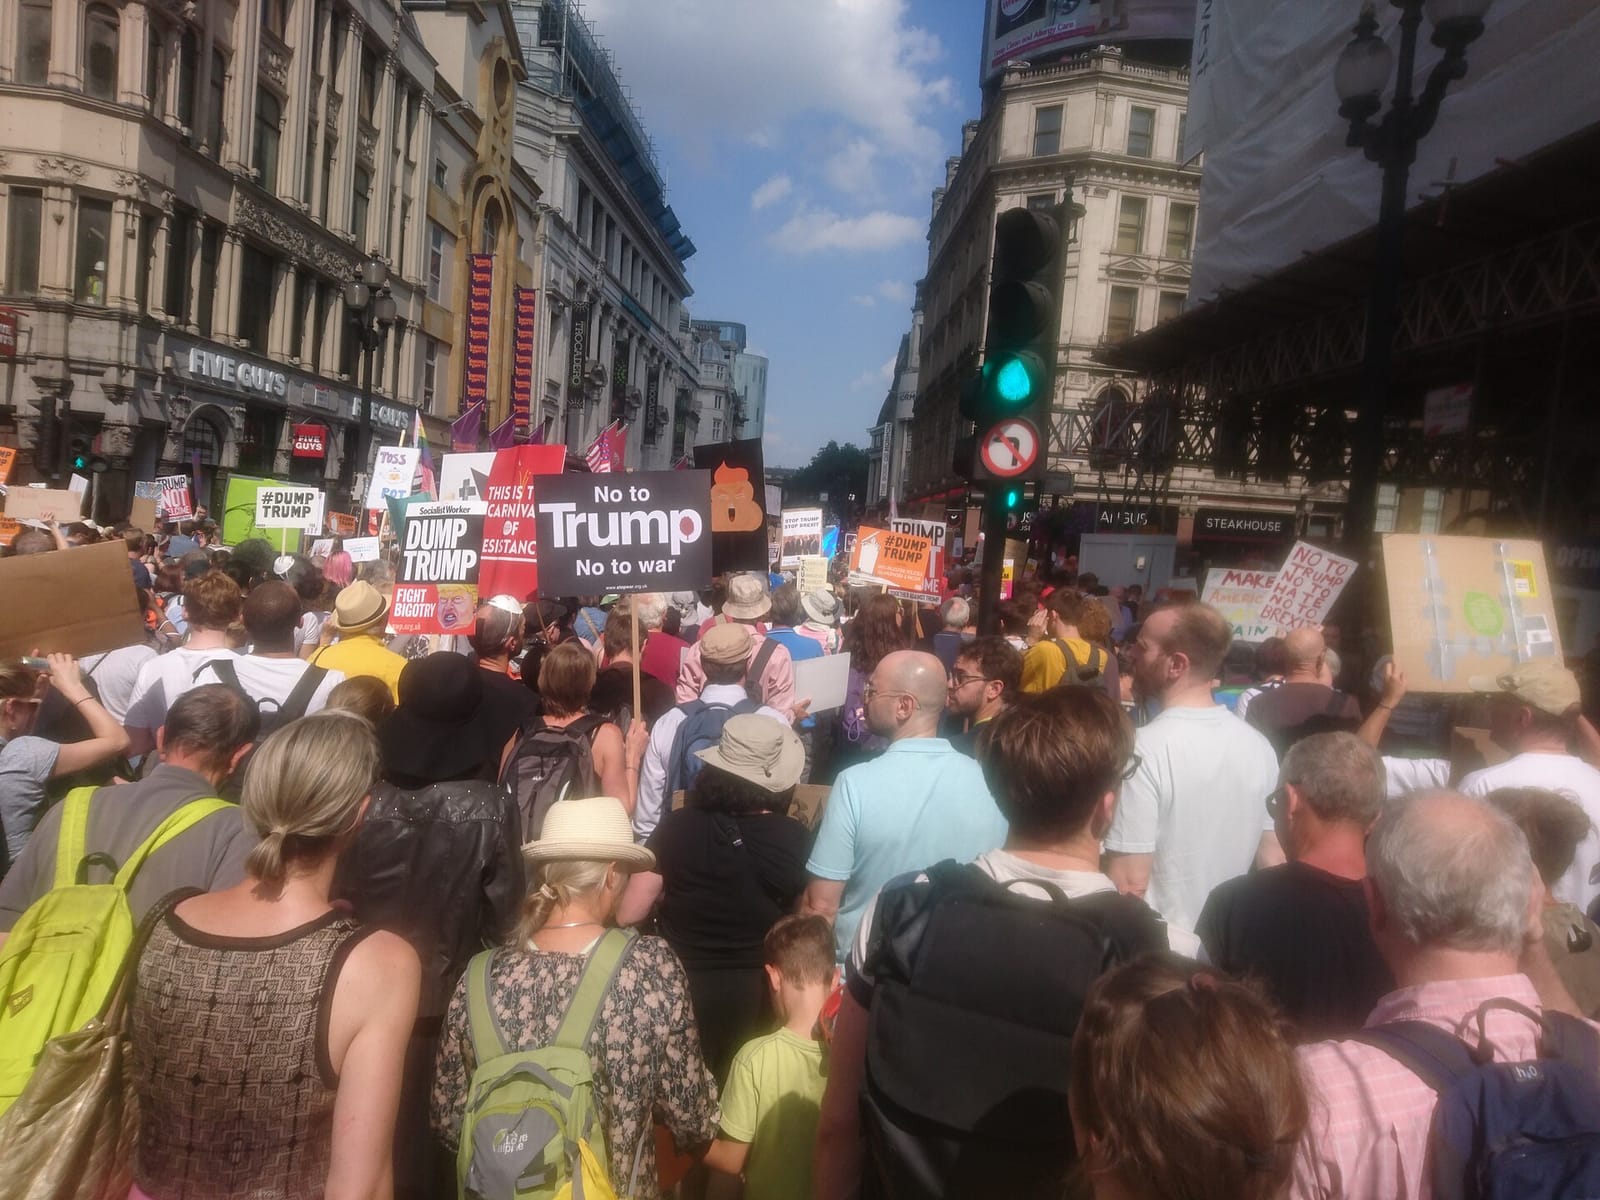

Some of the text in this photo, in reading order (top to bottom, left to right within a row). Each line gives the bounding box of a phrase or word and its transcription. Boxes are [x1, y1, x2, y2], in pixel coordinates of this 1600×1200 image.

[1057, 21, 1075, 31] Care
[572, 320, 584, 386] TROCADERO
[189, 347, 286, 396] FIVE GUYS
[378, 405, 409, 429] GUYS
[295, 442, 323, 451] GUYS
[298, 434, 321, 443] FIVE
[380, 451, 407, 465] TOSS
[161, 488, 187, 509] NOT
[261, 491, 315, 505] #DUMP
[381, 487, 407, 499] POT
[488, 486, 511, 500] THIS
[512, 485, 524, 500] IS
[594, 486, 650, 503] No to
[262, 505, 312, 518] TRUMP
[419, 506, 472, 515] Socialist Worker
[487, 504, 536, 518] CARNIVA
[406, 518, 467, 549] DUMP
[502, 520, 519, 536] OF
[538, 502, 703, 556] Trump
[1206, 518, 1281, 532] STEAKHOUSE
[481, 538, 537, 555] ESISTANC
[885, 535, 927, 552] #DUMP
[883, 546, 923, 563] TRUMP
[1293, 546, 1349, 576] NO TO
[404, 549, 477, 580] TRUMP
[576, 559, 676, 576] No to war
[1221, 570, 1277, 589] MAKE
[1291, 562, 1344, 587] TRUMP
[1281, 570, 1331, 598] NO TO
[396, 588, 427, 604] FIGHT
[394, 602, 436, 618] BIGOTRY
[1269, 594, 1317, 619] NO TO
